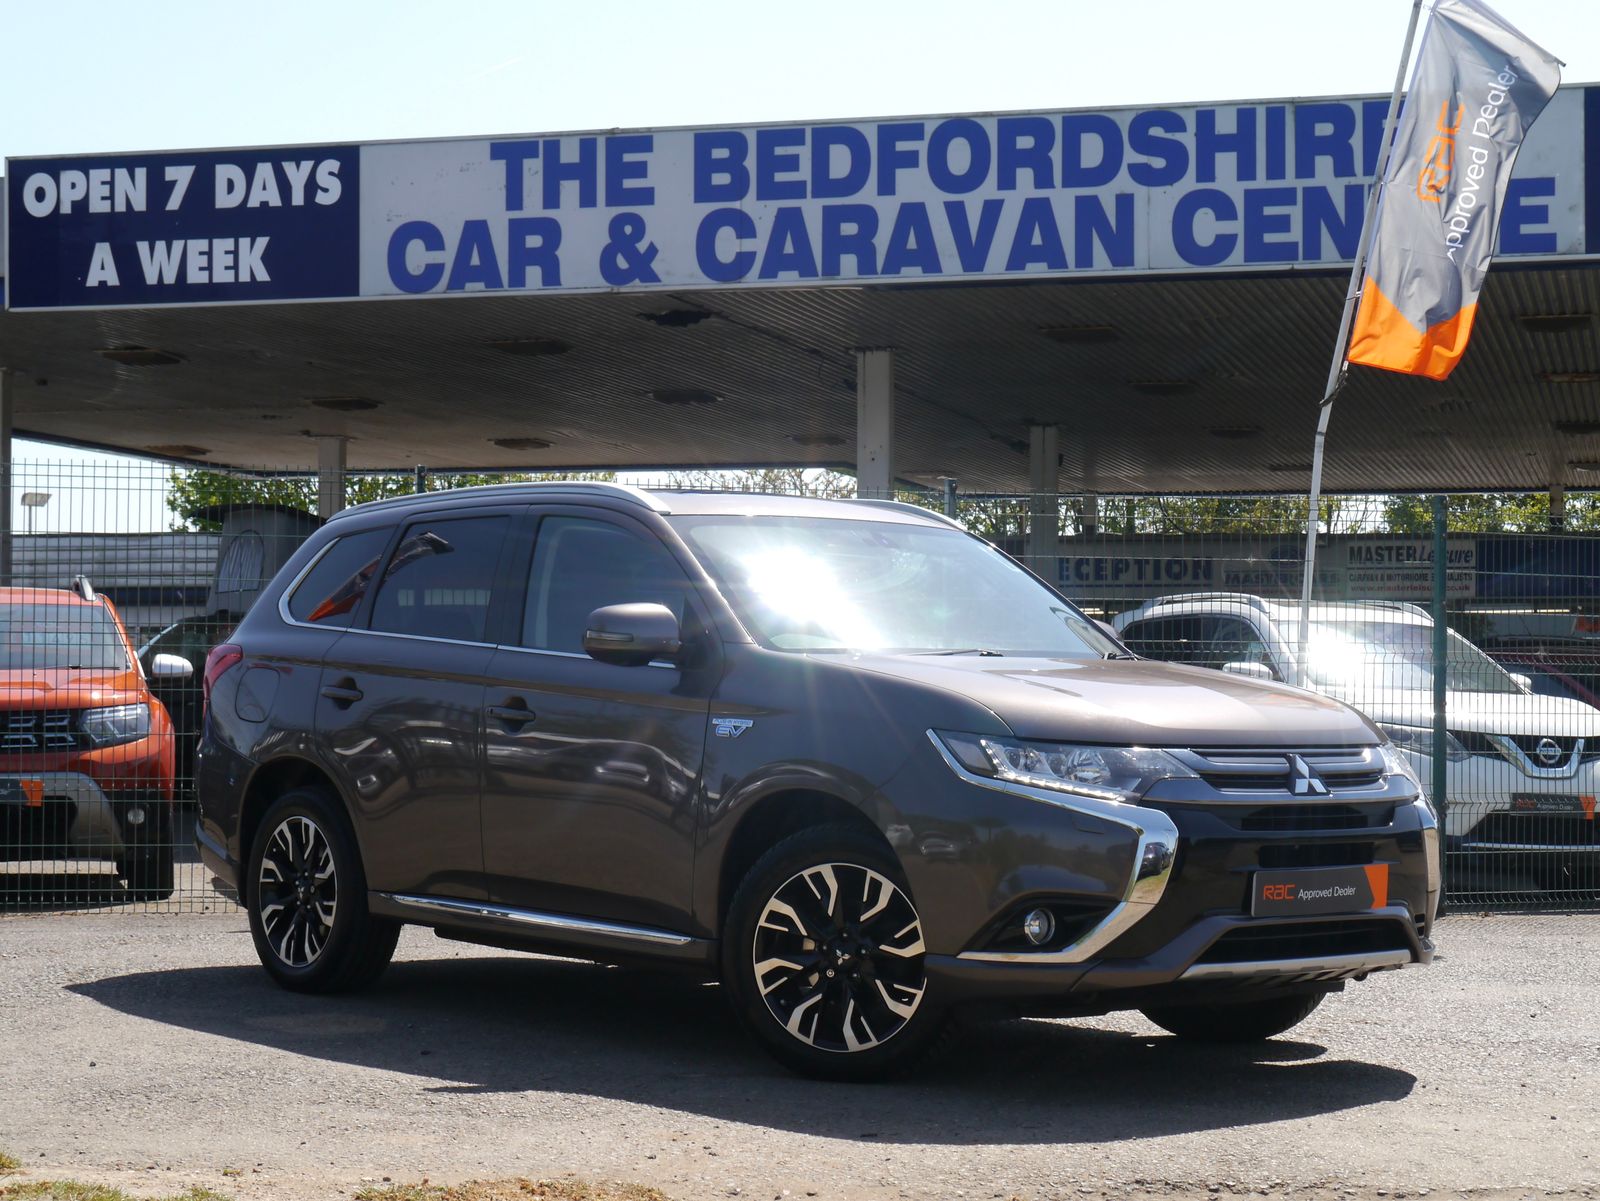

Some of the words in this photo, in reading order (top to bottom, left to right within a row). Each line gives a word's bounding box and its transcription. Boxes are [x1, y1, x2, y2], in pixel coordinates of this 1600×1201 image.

[1472, 65, 1518, 139] Dealer
[22, 167, 147, 218] OPEN
[164, 165, 196, 211] 7
[214, 159, 342, 209] DAYS
[490, 134, 655, 212] THE
[85, 242, 120, 287] A
[136, 236, 271, 285] WEEK
[387, 216, 562, 294] CAR
[599, 212, 662, 286] &
[695, 193, 1135, 283] CARAVAN
[1171, 176, 1558, 266] CENE
[1058, 557, 1213, 581] ECEPTION
[1298, 888, 1332, 900] Approved
[1333, 886, 1356, 897] Dealer
